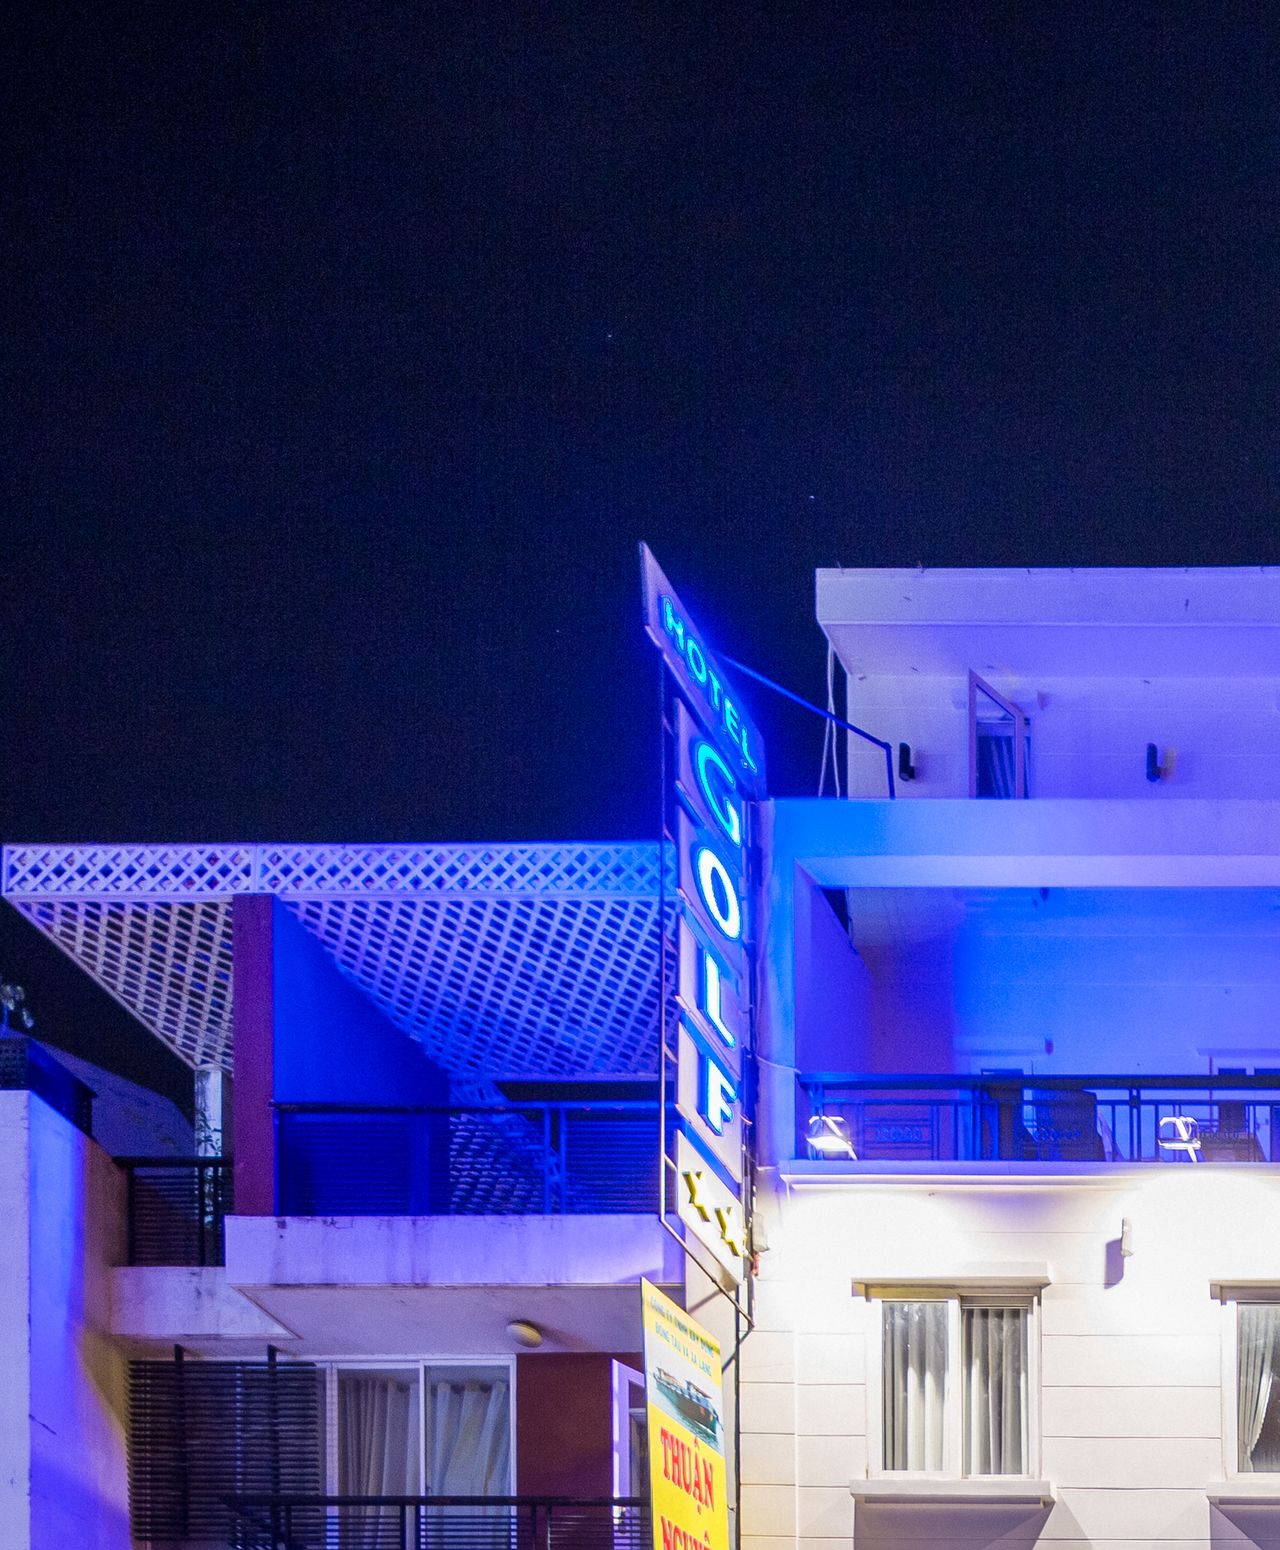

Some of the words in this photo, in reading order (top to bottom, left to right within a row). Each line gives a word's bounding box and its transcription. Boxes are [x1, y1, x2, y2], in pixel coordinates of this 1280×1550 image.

[660, 595, 759, 774] HOTEL
[698, 740, 742, 1136] GOLF
[660, 1425, 715, 1514] THUẬN
